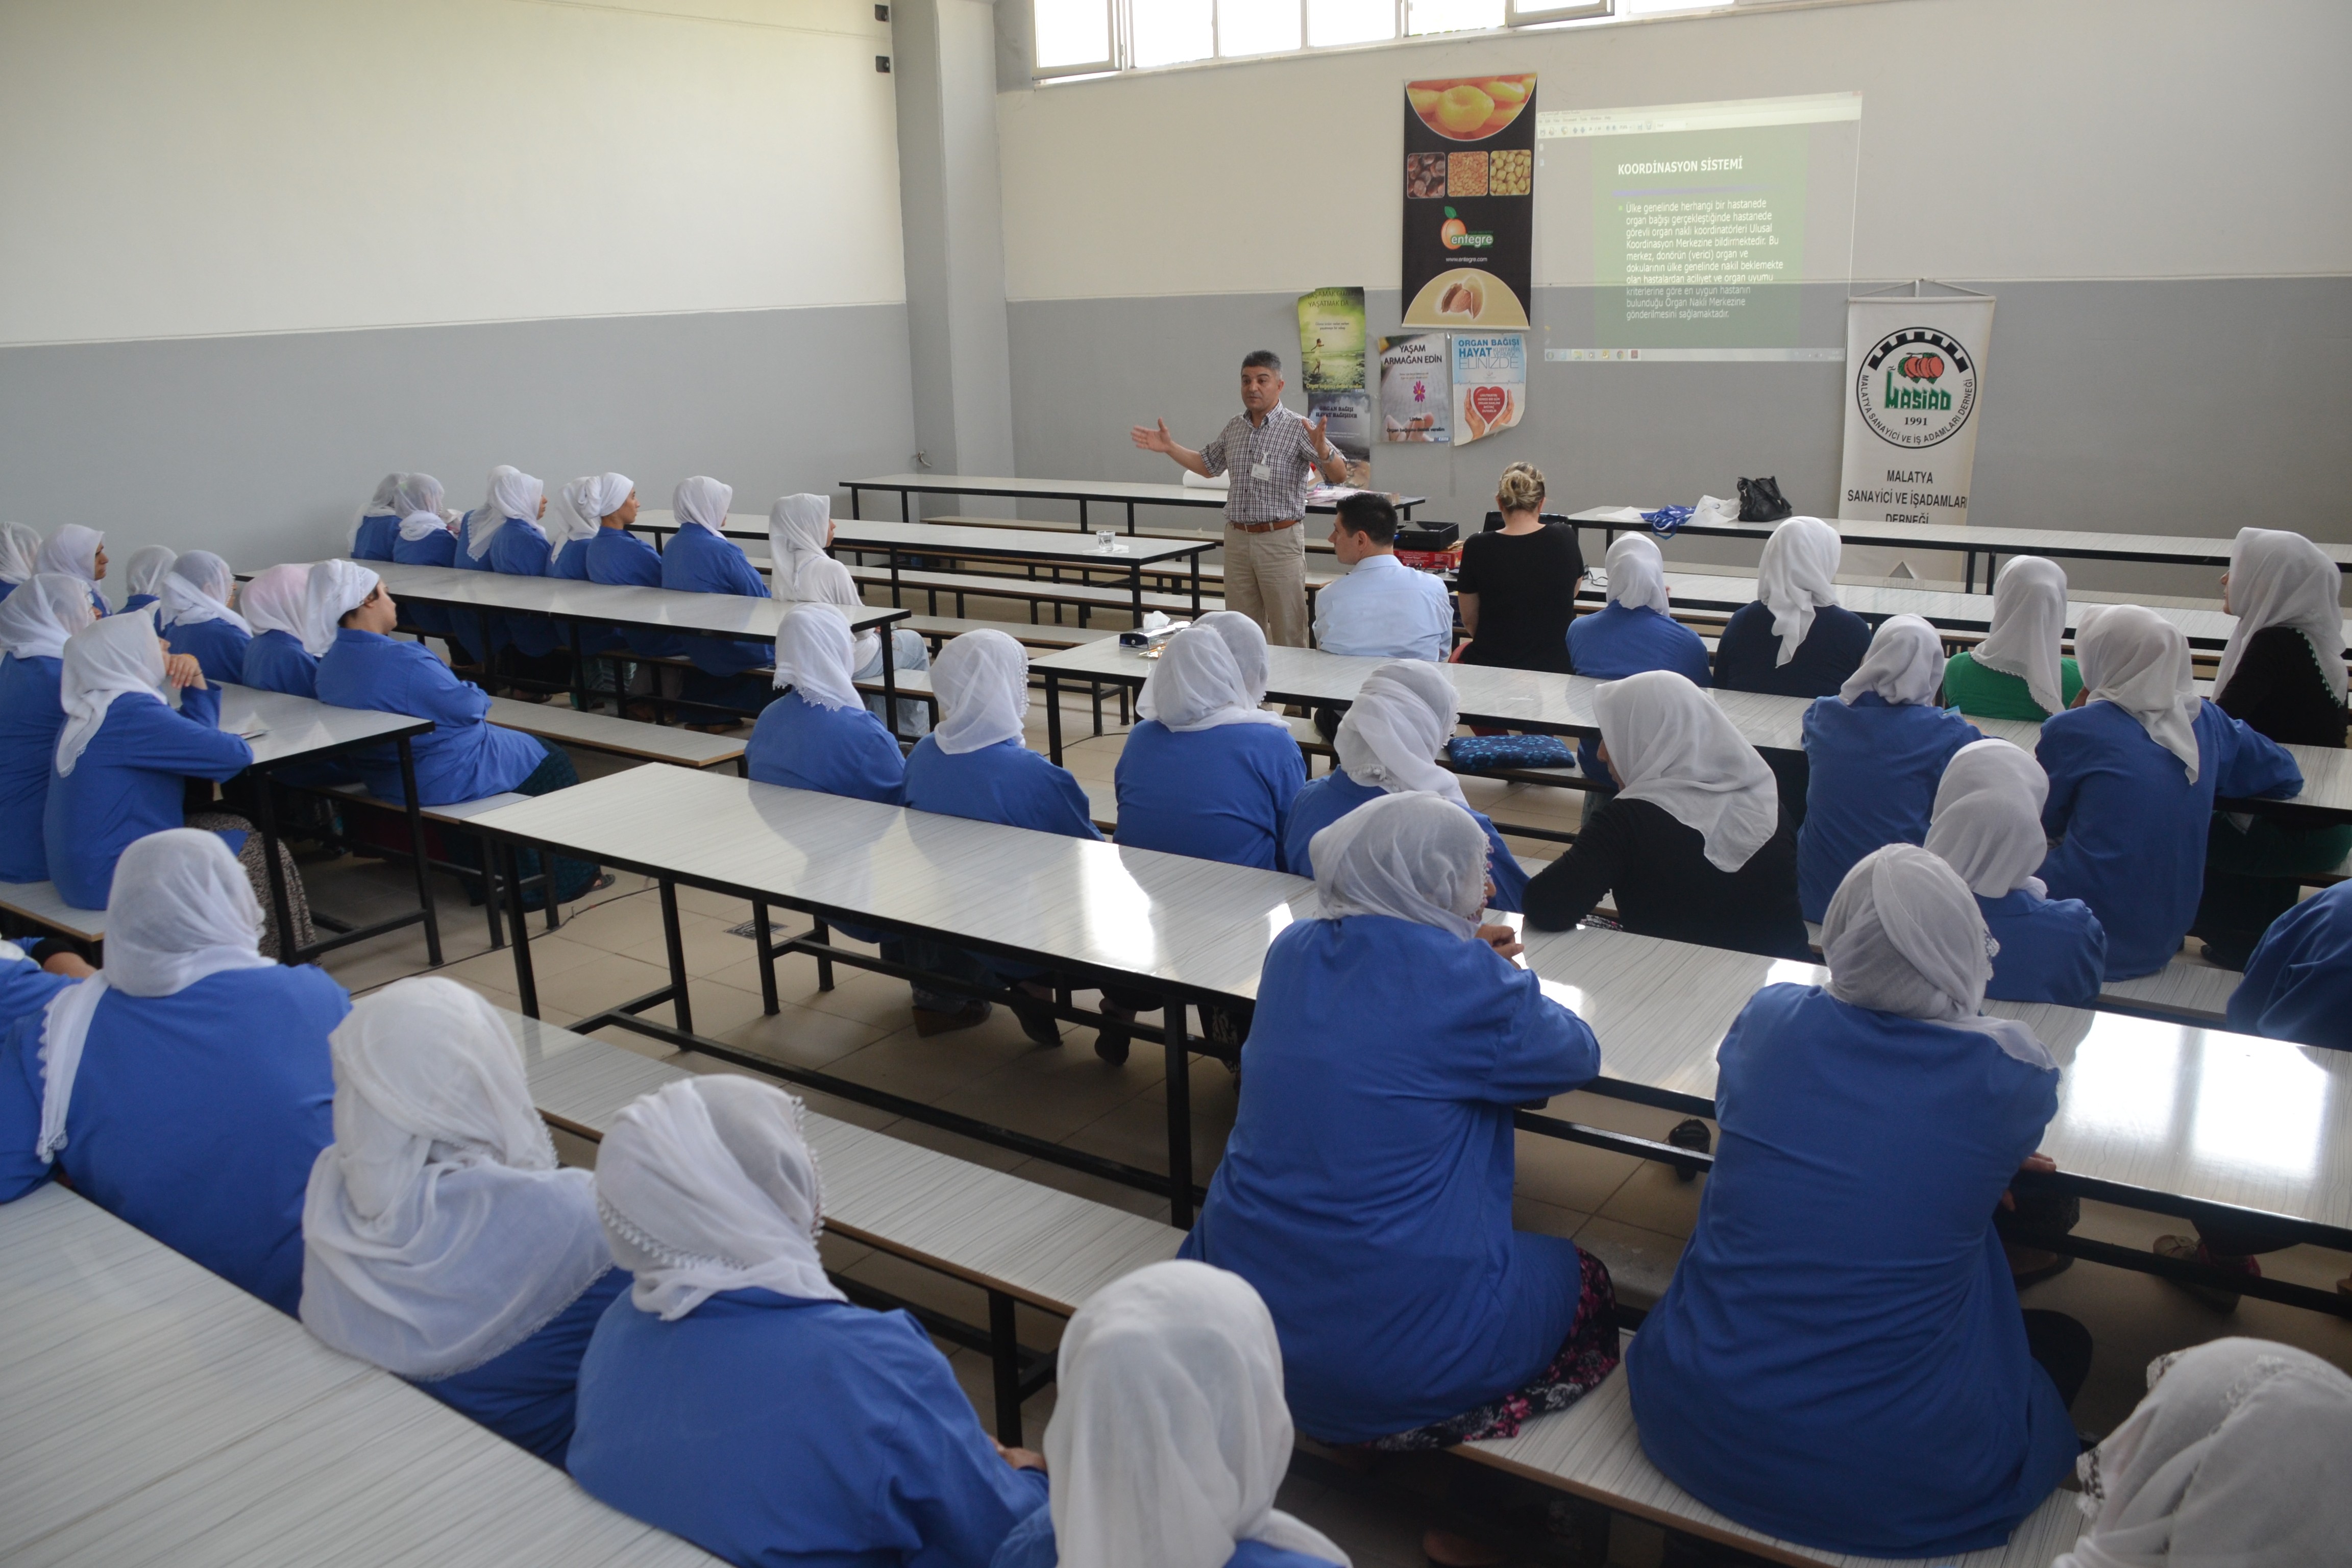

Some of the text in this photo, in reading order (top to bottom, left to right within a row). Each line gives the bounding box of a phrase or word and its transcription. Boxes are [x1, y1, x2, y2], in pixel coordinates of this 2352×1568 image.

[1618, 156, 1743, 175] KOORDİNASYON SİSTEMİ
[1626, 199, 1767, 214] Ülke genelinde herhangi bir hastanede
[1626, 211, 1772, 227] organ bağışı gerçekleştiğinde hastanede
[1626, 228, 1650, 239] görevli
[1652, 228, 1673, 238] organ
[1695, 225, 1747, 235] koordinatörleri
[1750, 223, 1772, 233] Ulusal
[1452, 234, 1492, 248] entegre
[1626, 235, 1779, 250] Koordinasyon Merkezine bildirmektedir. Bu
[1627, 252, 1654, 262] merkez,
[1656, 250, 1686, 259] donörün
[1688, 250, 1713, 261] (verici)
[1716, 251, 1737, 260] organ
[1626, 260, 1783, 273] dokularının ülke genelinde nakil beklemekte
[1626, 275, 1641, 284] olan
[1644, 275, 1684, 283] hastalardan
[1686, 274, 1711, 285] aciliyet
[1724, 274, 1746, 284] organ
[1748, 274, 1773, 283] uyumu
[1627, 287, 1663, 296] kriterlerine
[1666, 286, 1682, 297] göre
[1696, 287, 1717, 297] uygun
[1720, 286, 1750, 294] hastanın
[1627, 297, 1746, 309] bulunduğu Organ Nakli Merkezine
[1626, 309, 1729, 321] gönderilmesini sağlamaktadır.
[1491, 337, 1520, 347] BAĞIŞI
[1399, 345, 1426, 354] YAŞAM
[1459, 347, 1492, 357] HAYAT
[1384, 354, 1442, 365] ARMAĞAN EDİN
[1860, 374, 1973, 445] MALATYA SANAYİCİ VE İŞ ADAMLARI DERNEĞİ
[1904, 417, 1927, 426] 1991
[1886, 470, 1933, 483] MALATYA
[1848, 488, 1968, 508] SANAYİCİ VE İŞADAMLARI
